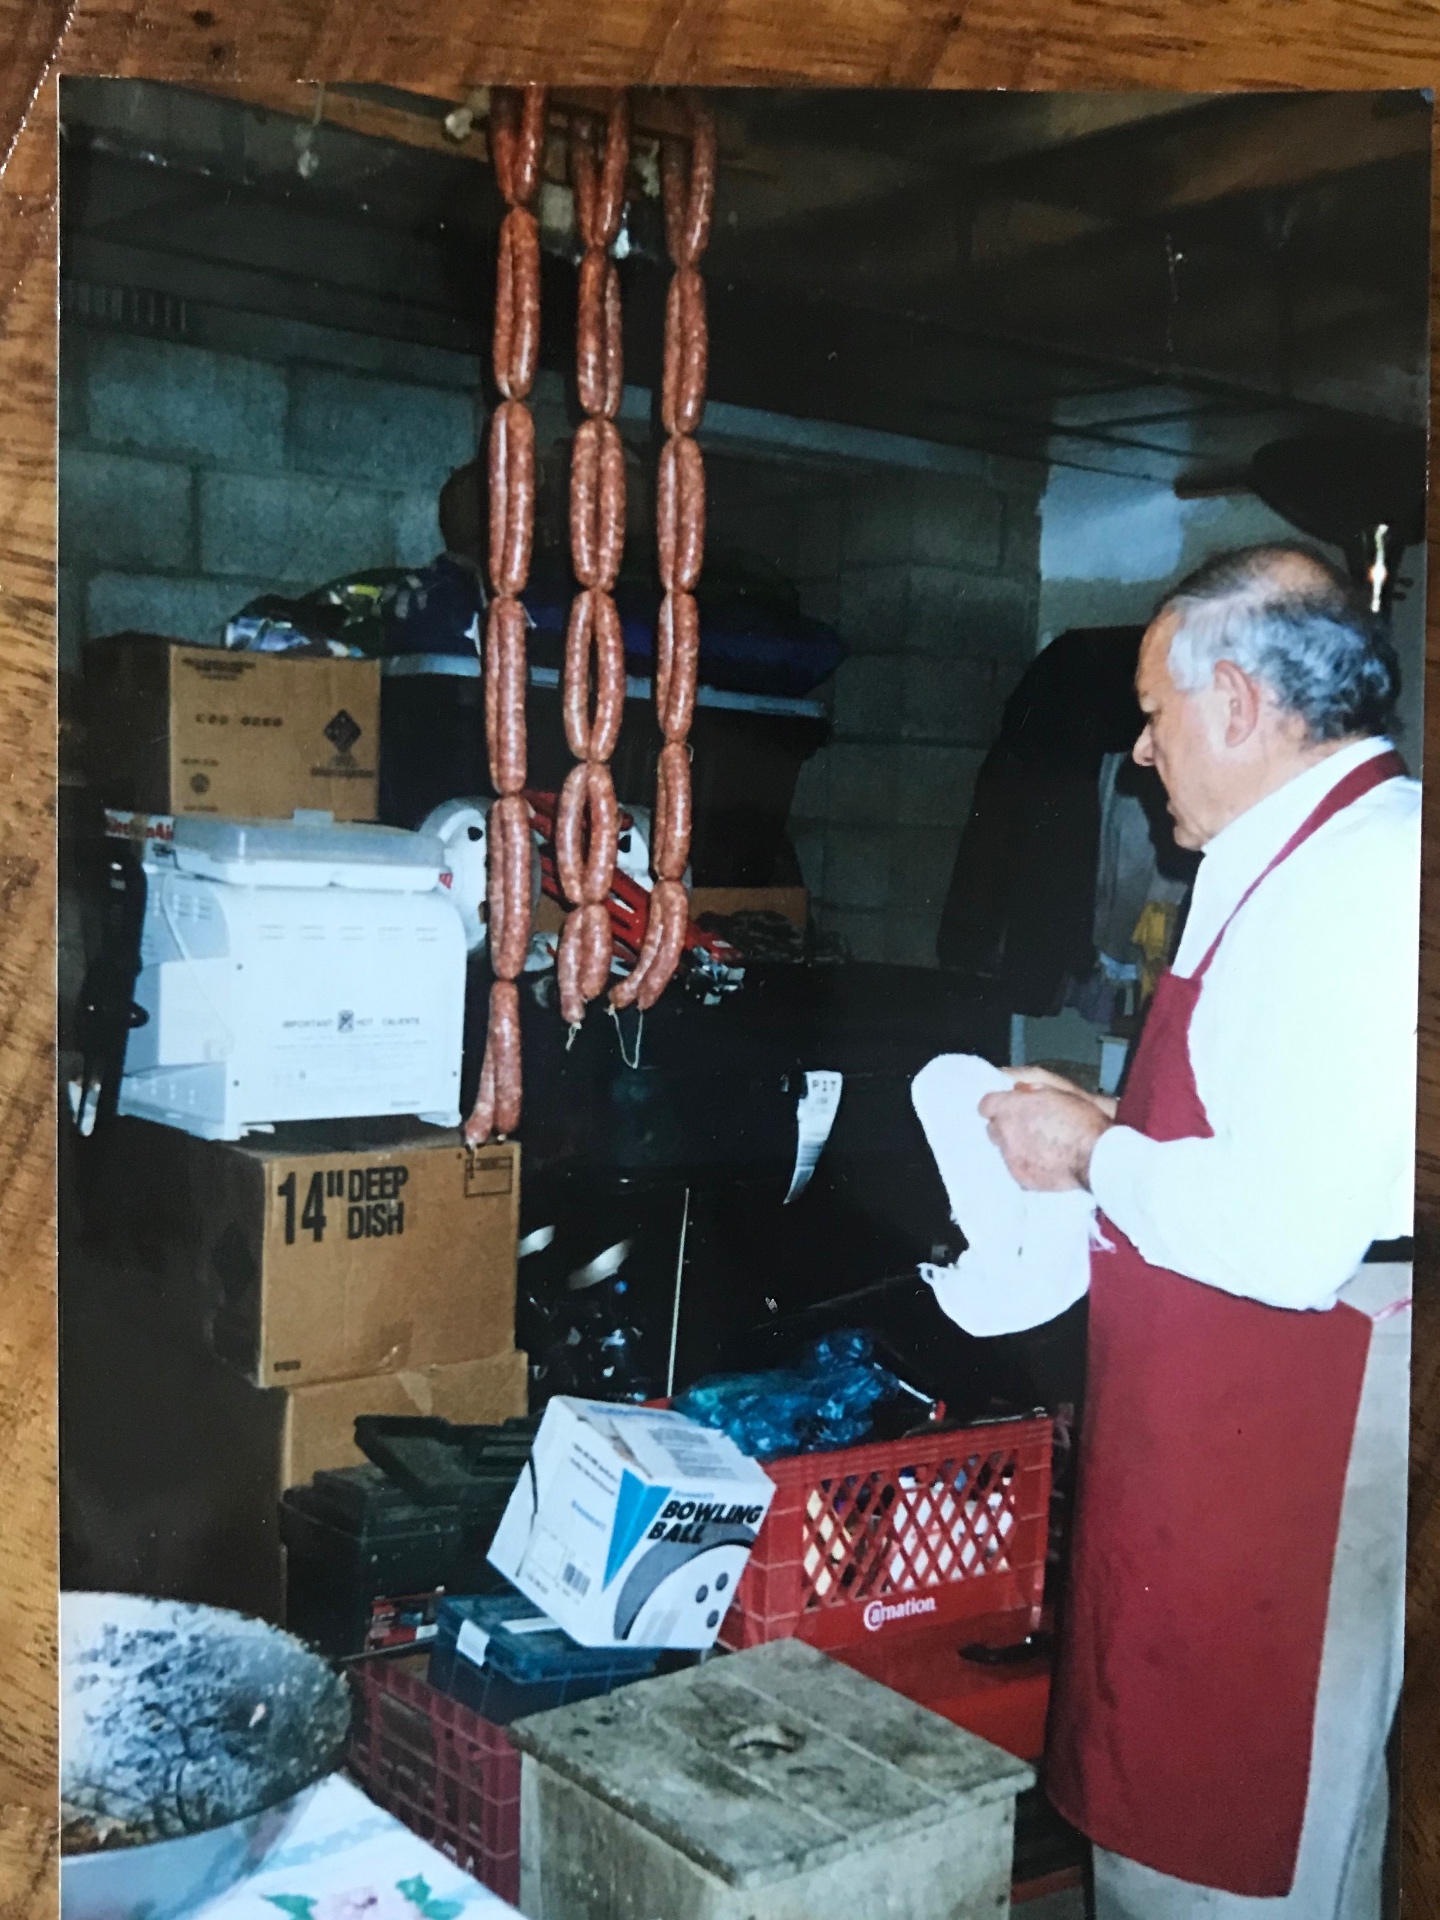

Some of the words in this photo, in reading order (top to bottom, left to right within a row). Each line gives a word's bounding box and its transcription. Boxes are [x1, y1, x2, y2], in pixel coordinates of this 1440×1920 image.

[277, 1169, 344, 1246] 14"
[347, 1165, 409, 1203] DEEP
[347, 1201, 405, 1240] DISH
[660, 1500, 764, 1524] BOWLING
[647, 1521, 706, 1544] BALL
[863, 1597, 937, 1632] Carnation
